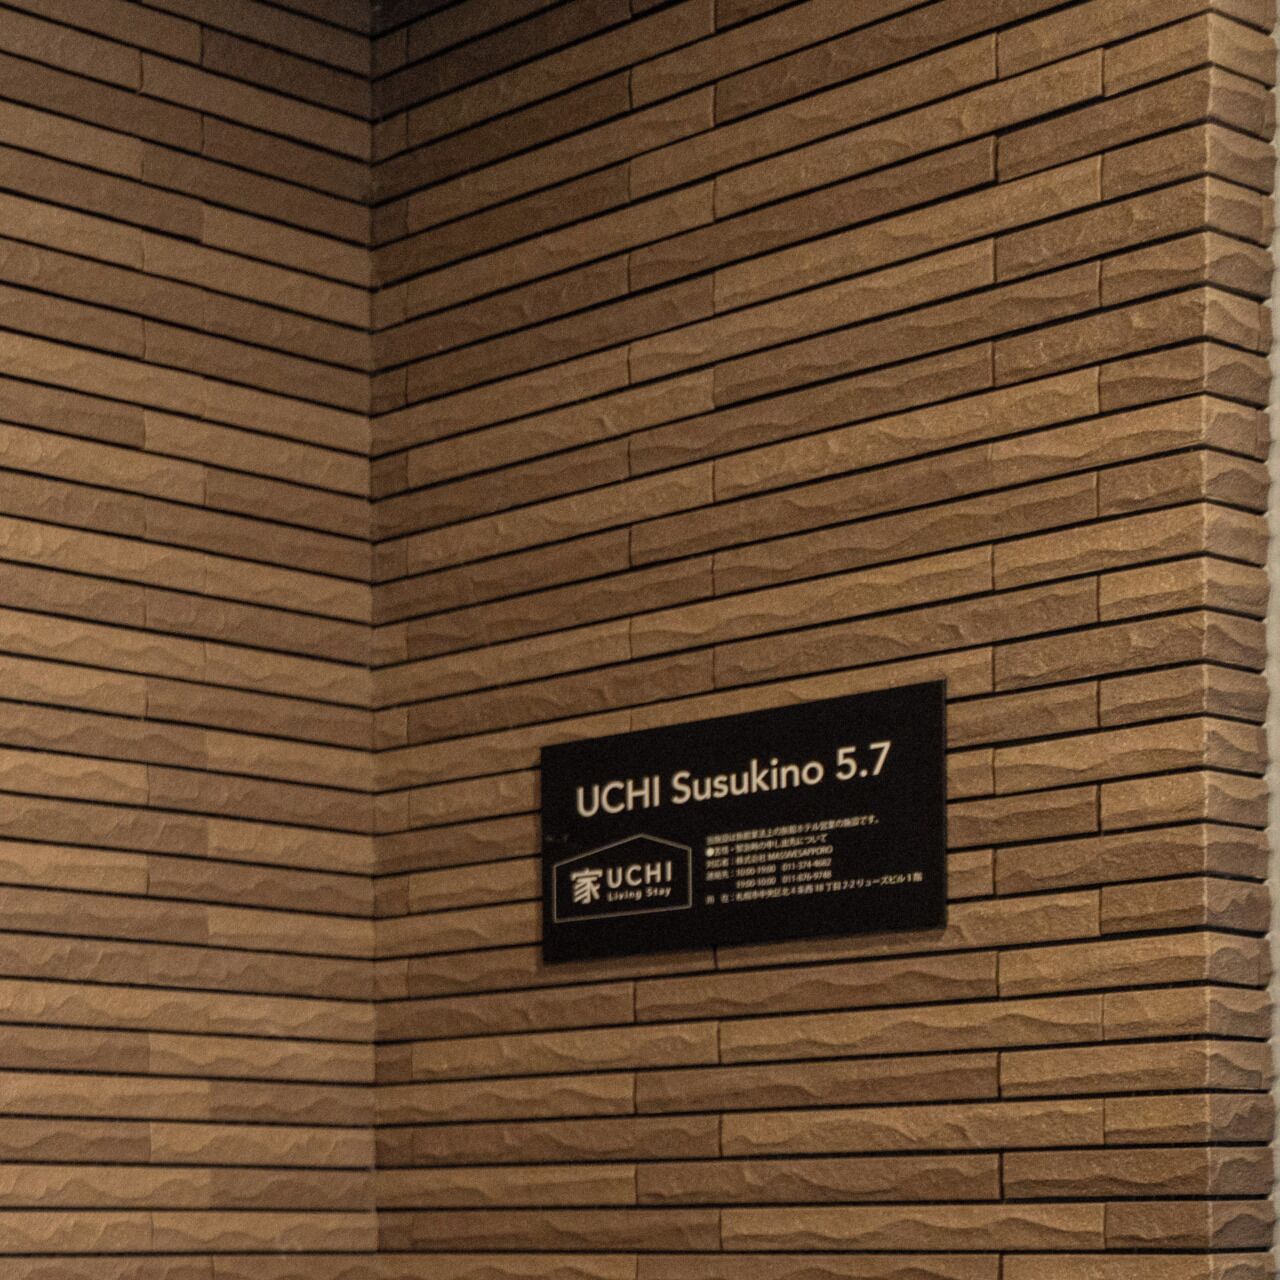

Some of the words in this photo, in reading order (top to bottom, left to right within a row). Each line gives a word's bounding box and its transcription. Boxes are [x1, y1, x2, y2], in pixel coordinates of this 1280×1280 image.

[576, 775, 661, 818] UCHI
[671, 757, 825, 805] Susukino
[835, 740, 892, 781] 5.7
[570, 868, 603, 904] 家
[606, 860, 673, 889] UCHI
[607, 891, 642, 903] Living
[645, 886, 672, 899] Stay
